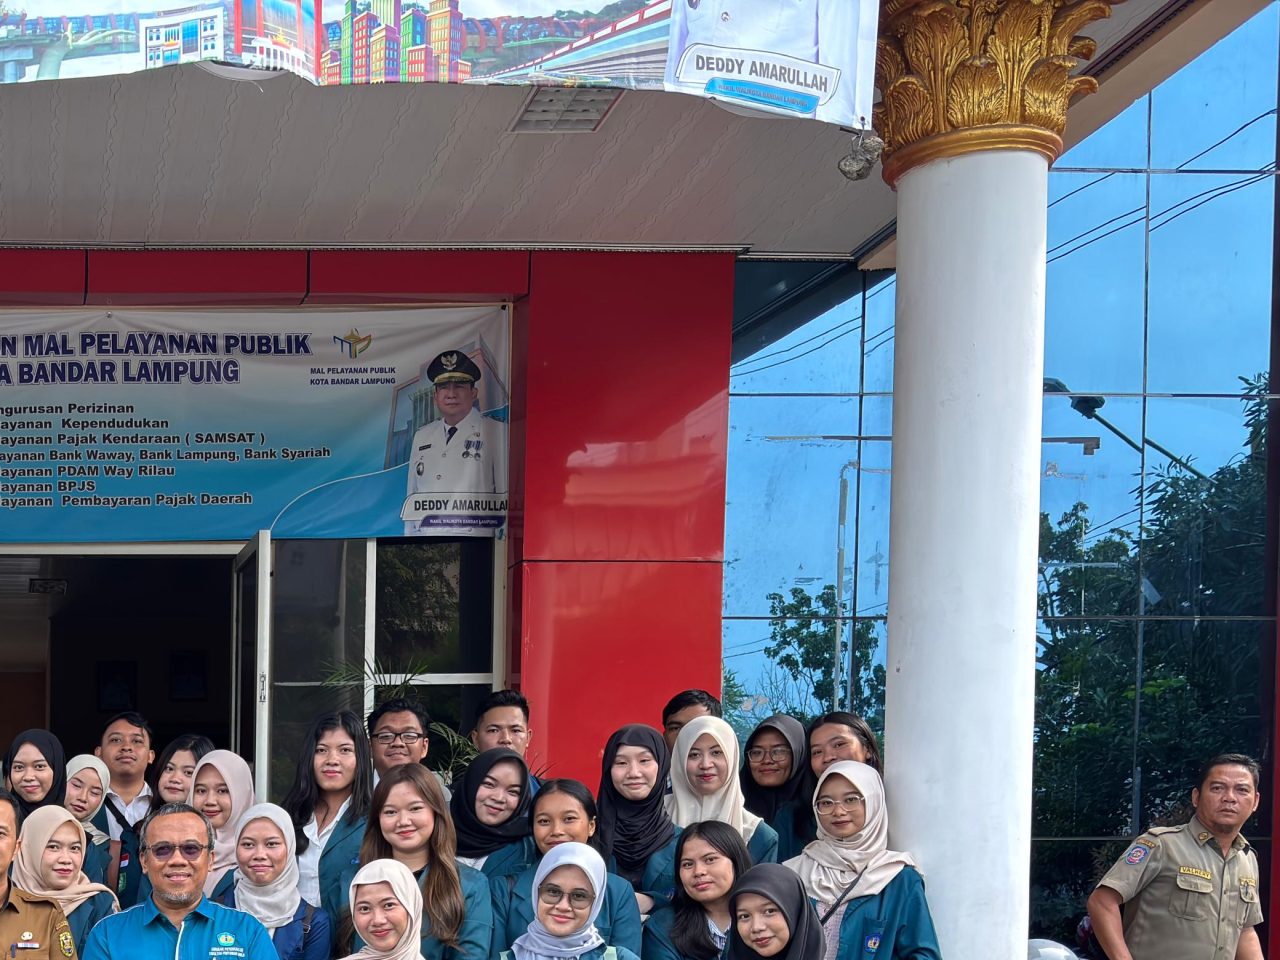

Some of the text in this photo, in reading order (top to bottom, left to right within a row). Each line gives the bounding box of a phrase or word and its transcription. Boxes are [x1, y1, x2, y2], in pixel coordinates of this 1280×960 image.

[696, 55, 827, 92] DEDDY AMARULLAH
[24, 334, 74, 356] MAL
[81, 333, 218, 355] PELAYANAN
[225, 334, 311, 354] PUBLIK
[19, 361, 116, 384] BANDAR
[123, 359, 240, 383] LAMPUNG
[361, 377, 396, 385] LAMPUNG
[68, 404, 134, 414] Perizinan
[62, 418, 169, 431] Kependudukan
[57, 434, 97, 446] Pajak
[102, 432, 180, 444] Kendaraan
[195, 432, 255, 443] SAMSAT
[50, 450, 82, 461] Bank
[87, 450, 135, 463] Waway,
[139, 449, 172, 460] Bank
[177, 449, 239, 462] Lampung,
[245, 448, 276, 459] Bank
[281, 447, 330, 460] Syariah
[57, 466, 99, 477] PDAM
[103, 466, 134, 478] Way
[138, 465, 175, 476] Rilau
[57, 480, 96, 492] BPJS
[62, 495, 150, 508] Pembayaran
[156, 494, 195, 506] Pajak
[200, 493, 252, 505] Daerah
[414, 499, 449, 511] DEDDY
